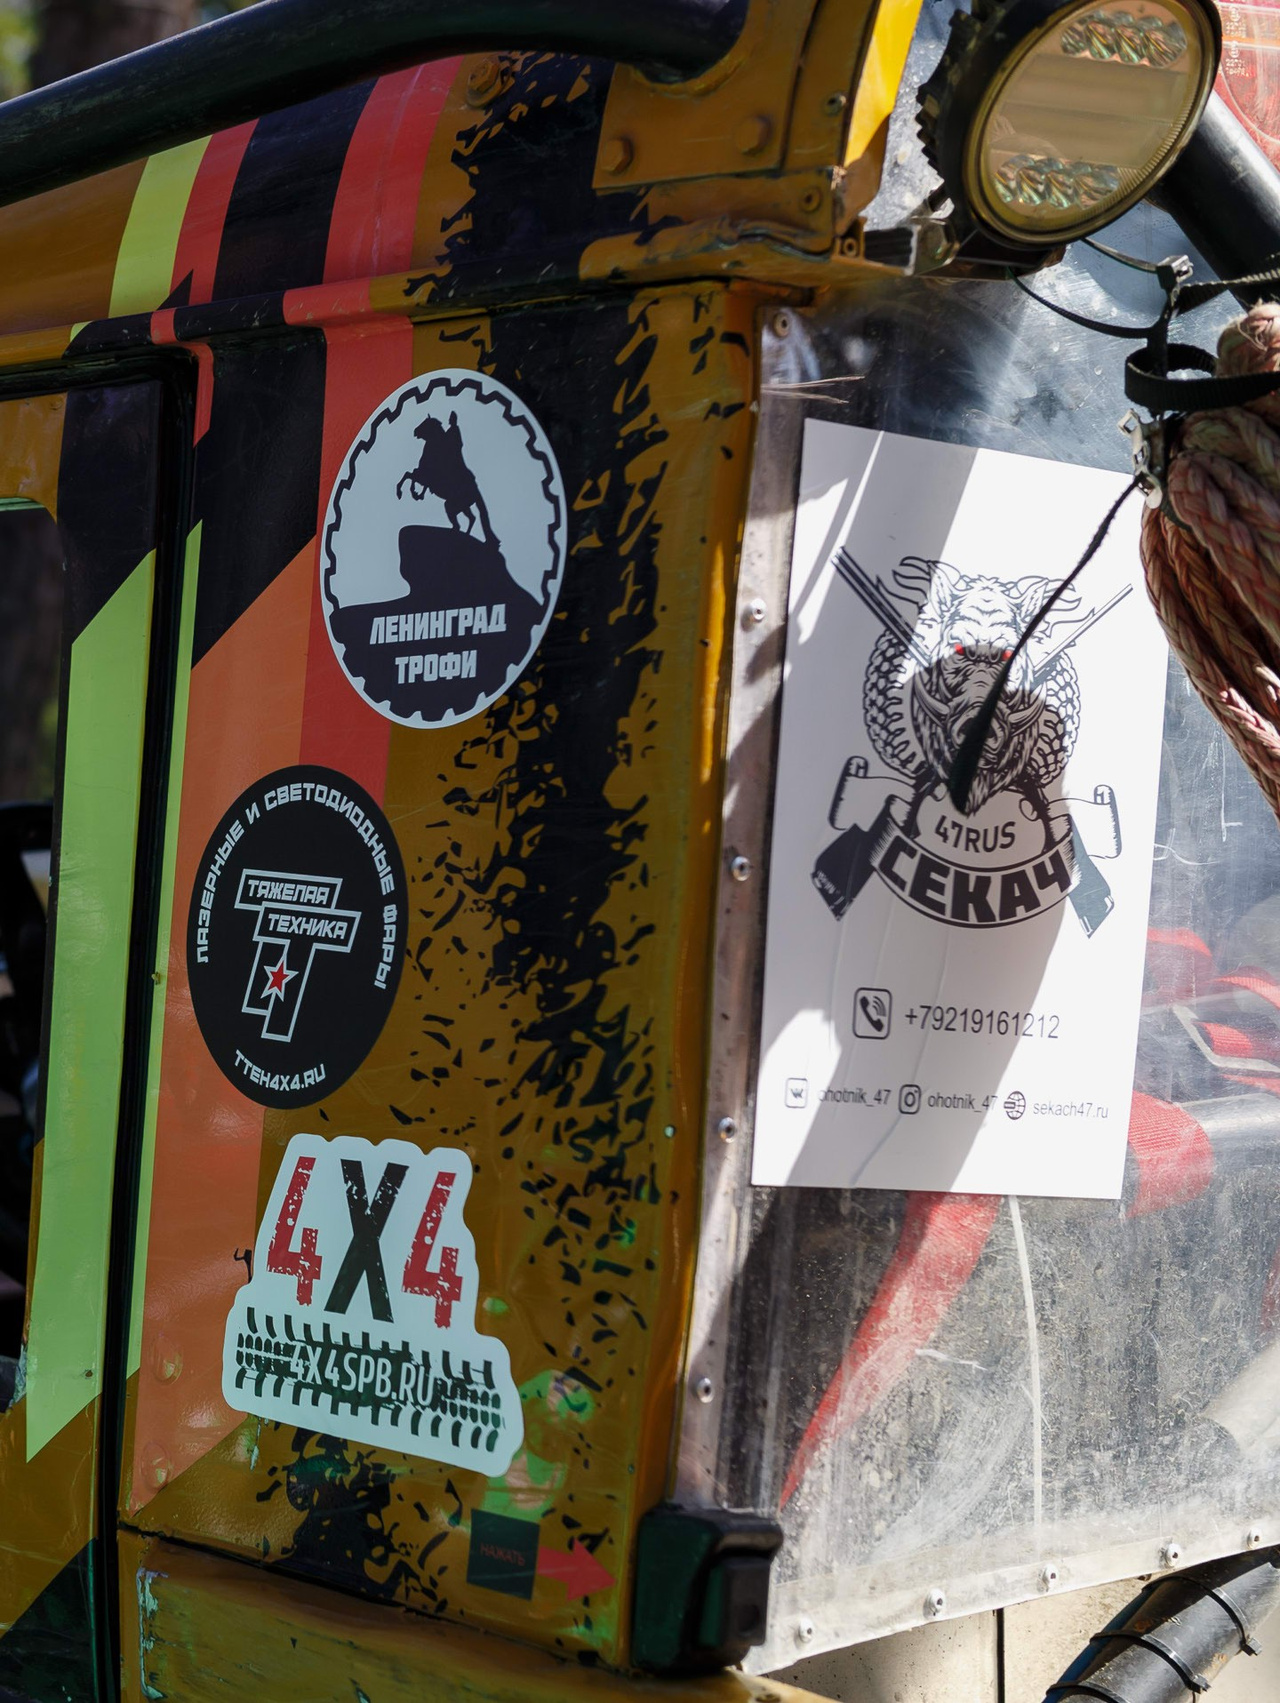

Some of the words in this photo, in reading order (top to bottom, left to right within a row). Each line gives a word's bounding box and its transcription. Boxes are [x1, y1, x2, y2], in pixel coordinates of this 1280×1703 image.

[369, 603, 507, 645] ЛЕНИНГРАД
[394, 650, 477, 684] ТРОФИ
[935, 815, 1016, 853] 47RUS
[196, 819, 245, 964] ЛАЗЕРНЫЕ
[245, 802, 260, 825] И
[264, 782, 395, 896] СВЕТОДИОДНЫЕ
[373, 904, 397, 990] ФАРЫ
[247, 878, 331, 905] ТЯЖЕЛАЯ
[878, 835, 1072, 923] СЕКАЧ
[268, 913, 348, 940] ТЕХНИКА
[905, 1005, 1060, 1039] +79219161212
[234, 1049, 326, 1091] TTEH4X4.RU
[927, 1093, 998, 1113] ohotnik_47
[1033, 1101, 1109, 1119] sekach47.ru
[266, 1156, 463, 1329] 4X4
[291, 1344, 436, 1407] 4X4SPB.RU
